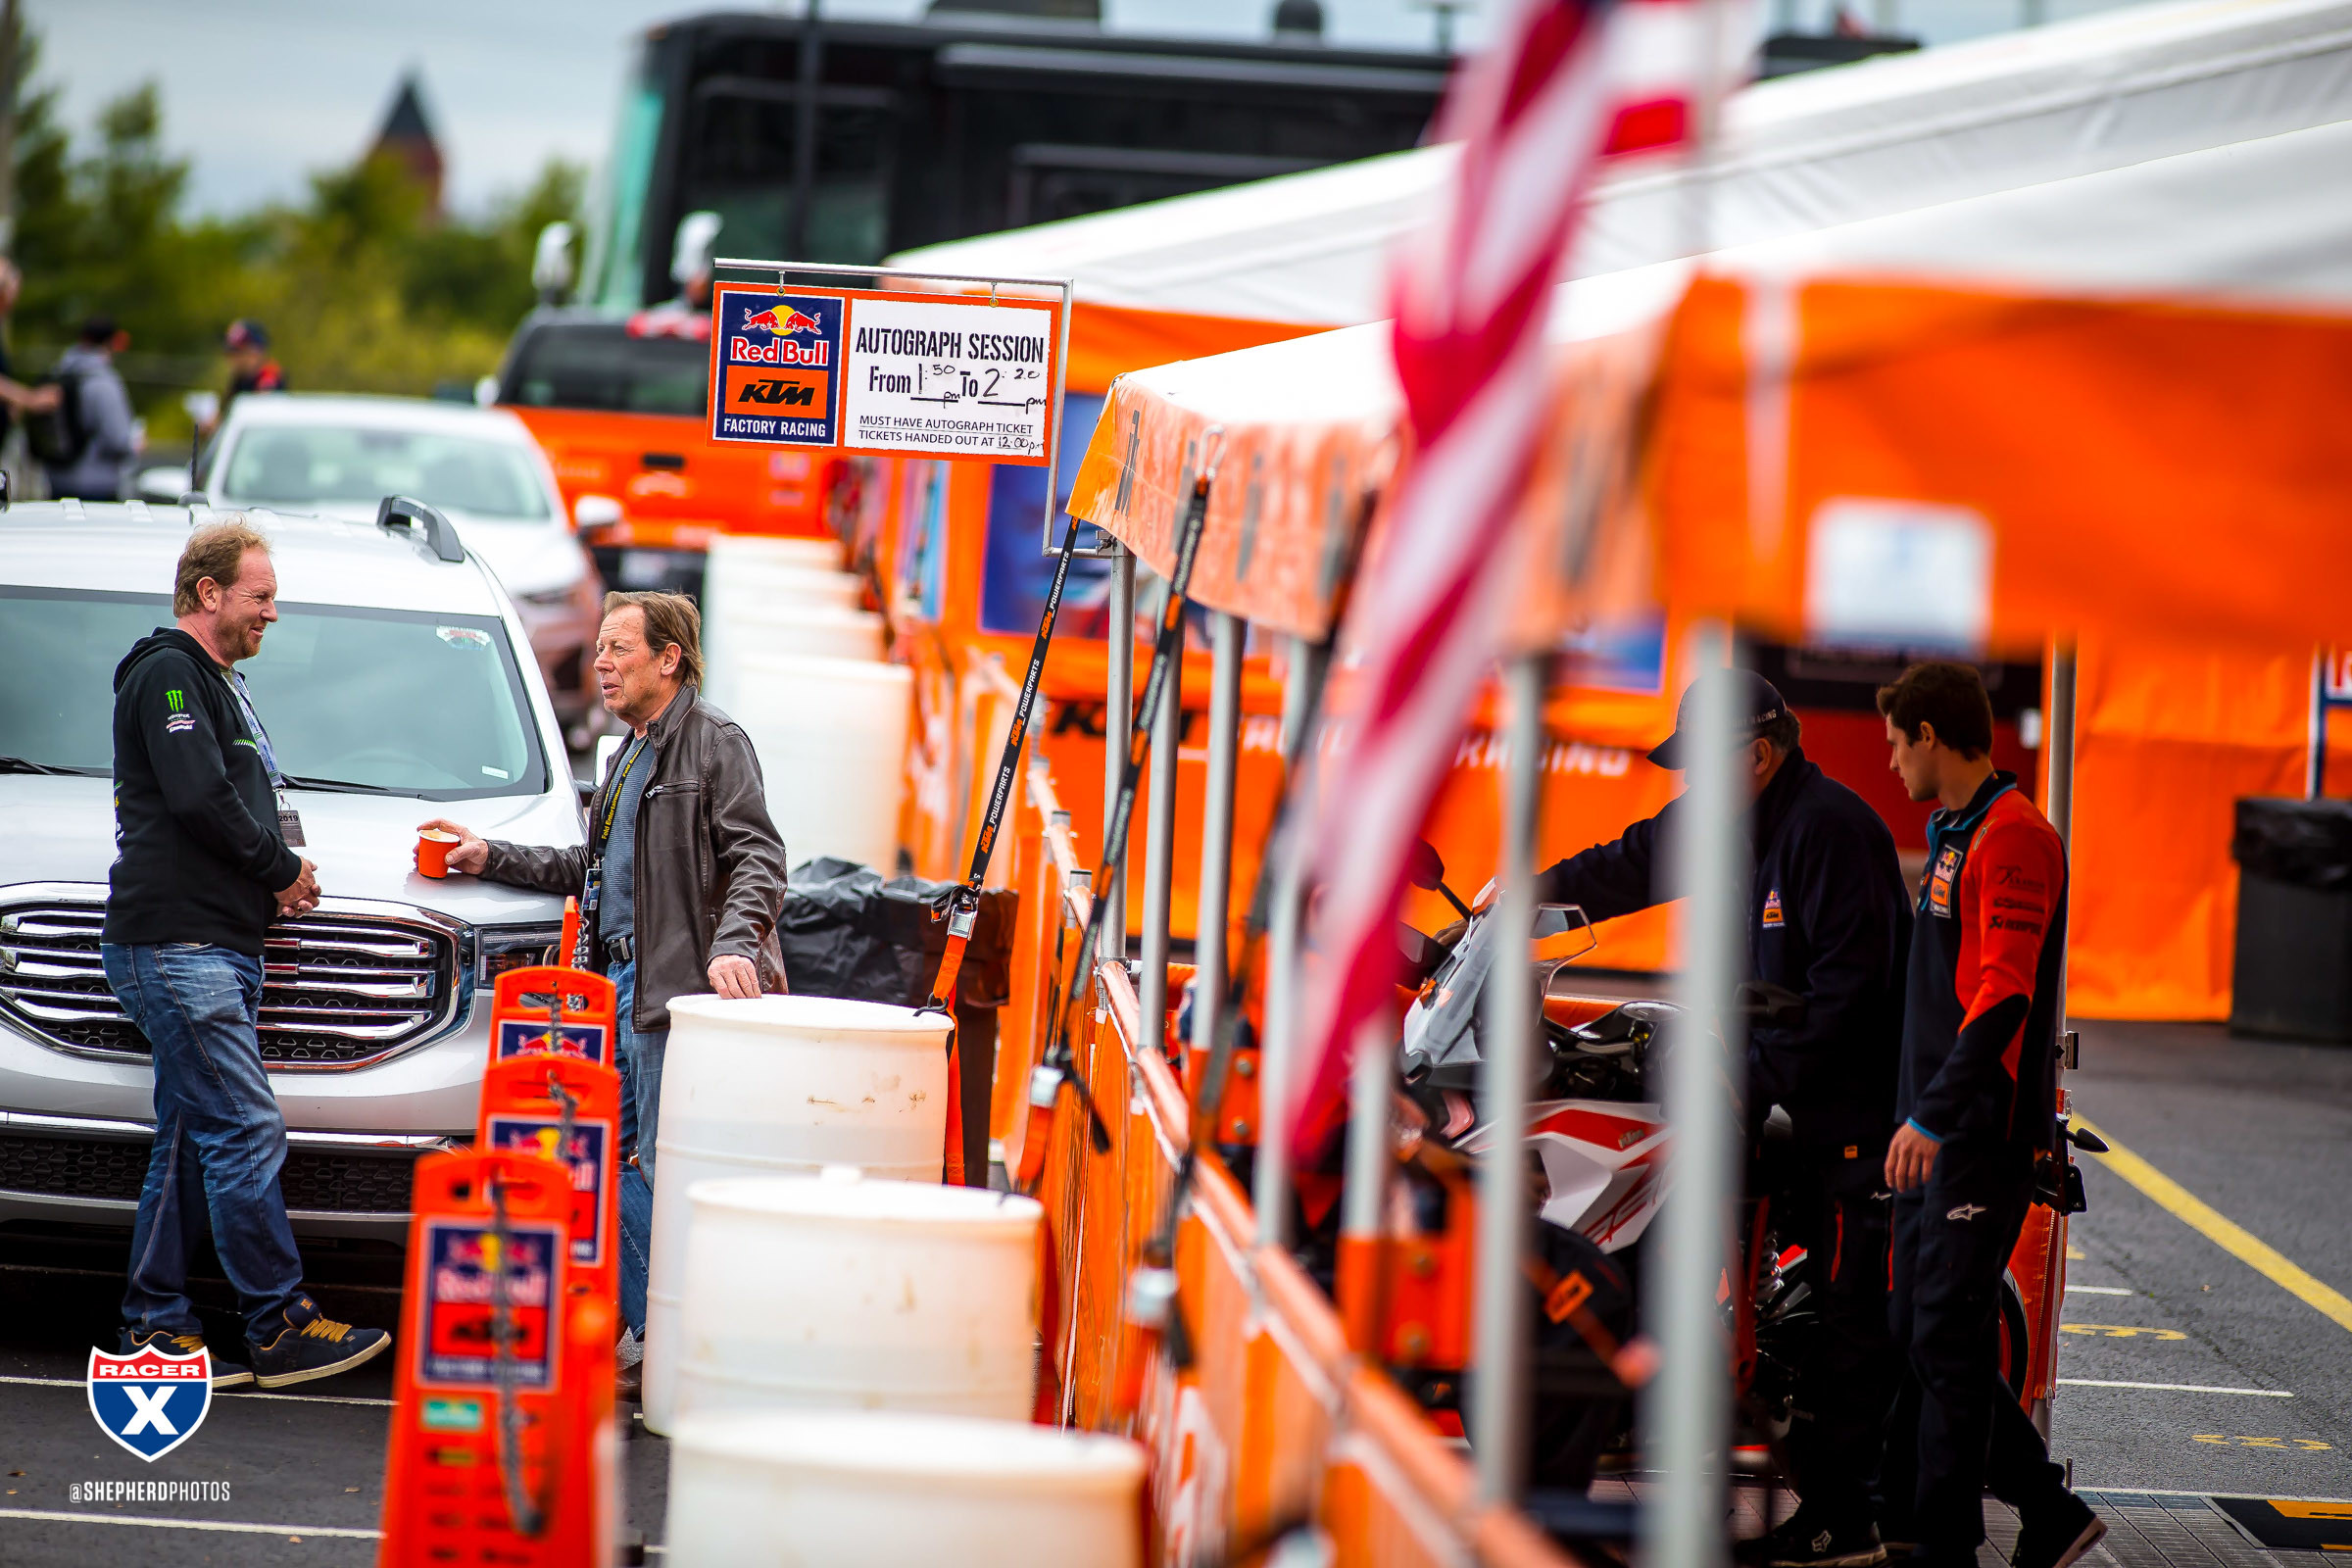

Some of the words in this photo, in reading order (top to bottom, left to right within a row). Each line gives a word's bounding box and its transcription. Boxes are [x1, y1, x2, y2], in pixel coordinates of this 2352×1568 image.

[731, 336, 781, 363] Red
[782, 339, 829, 366] Bull
[856, 326, 961, 359] AUTOGRAPH
[967, 332, 1045, 364] SESSION
[738, 379, 815, 406] KTM
[869, 366, 911, 394] From
[959, 370, 979, 398] To
[723, 417, 777, 434] FACTORY
[780, 421, 826, 437] RACING
[859, 415, 892, 426] MUST
[894, 416, 923, 428] HAVE
[925, 418, 995, 432] AUTOGRAPH
[998, 422, 1034, 434] TICKET
[858, 429, 903, 442] TICKETS
[905, 432, 953, 445] HANDED
[955, 435, 979, 447] OUT
[981, 437, 995, 448] AT
[605, 781, 623, 826] Entertainment
[601, 825, 611, 840] Feld
